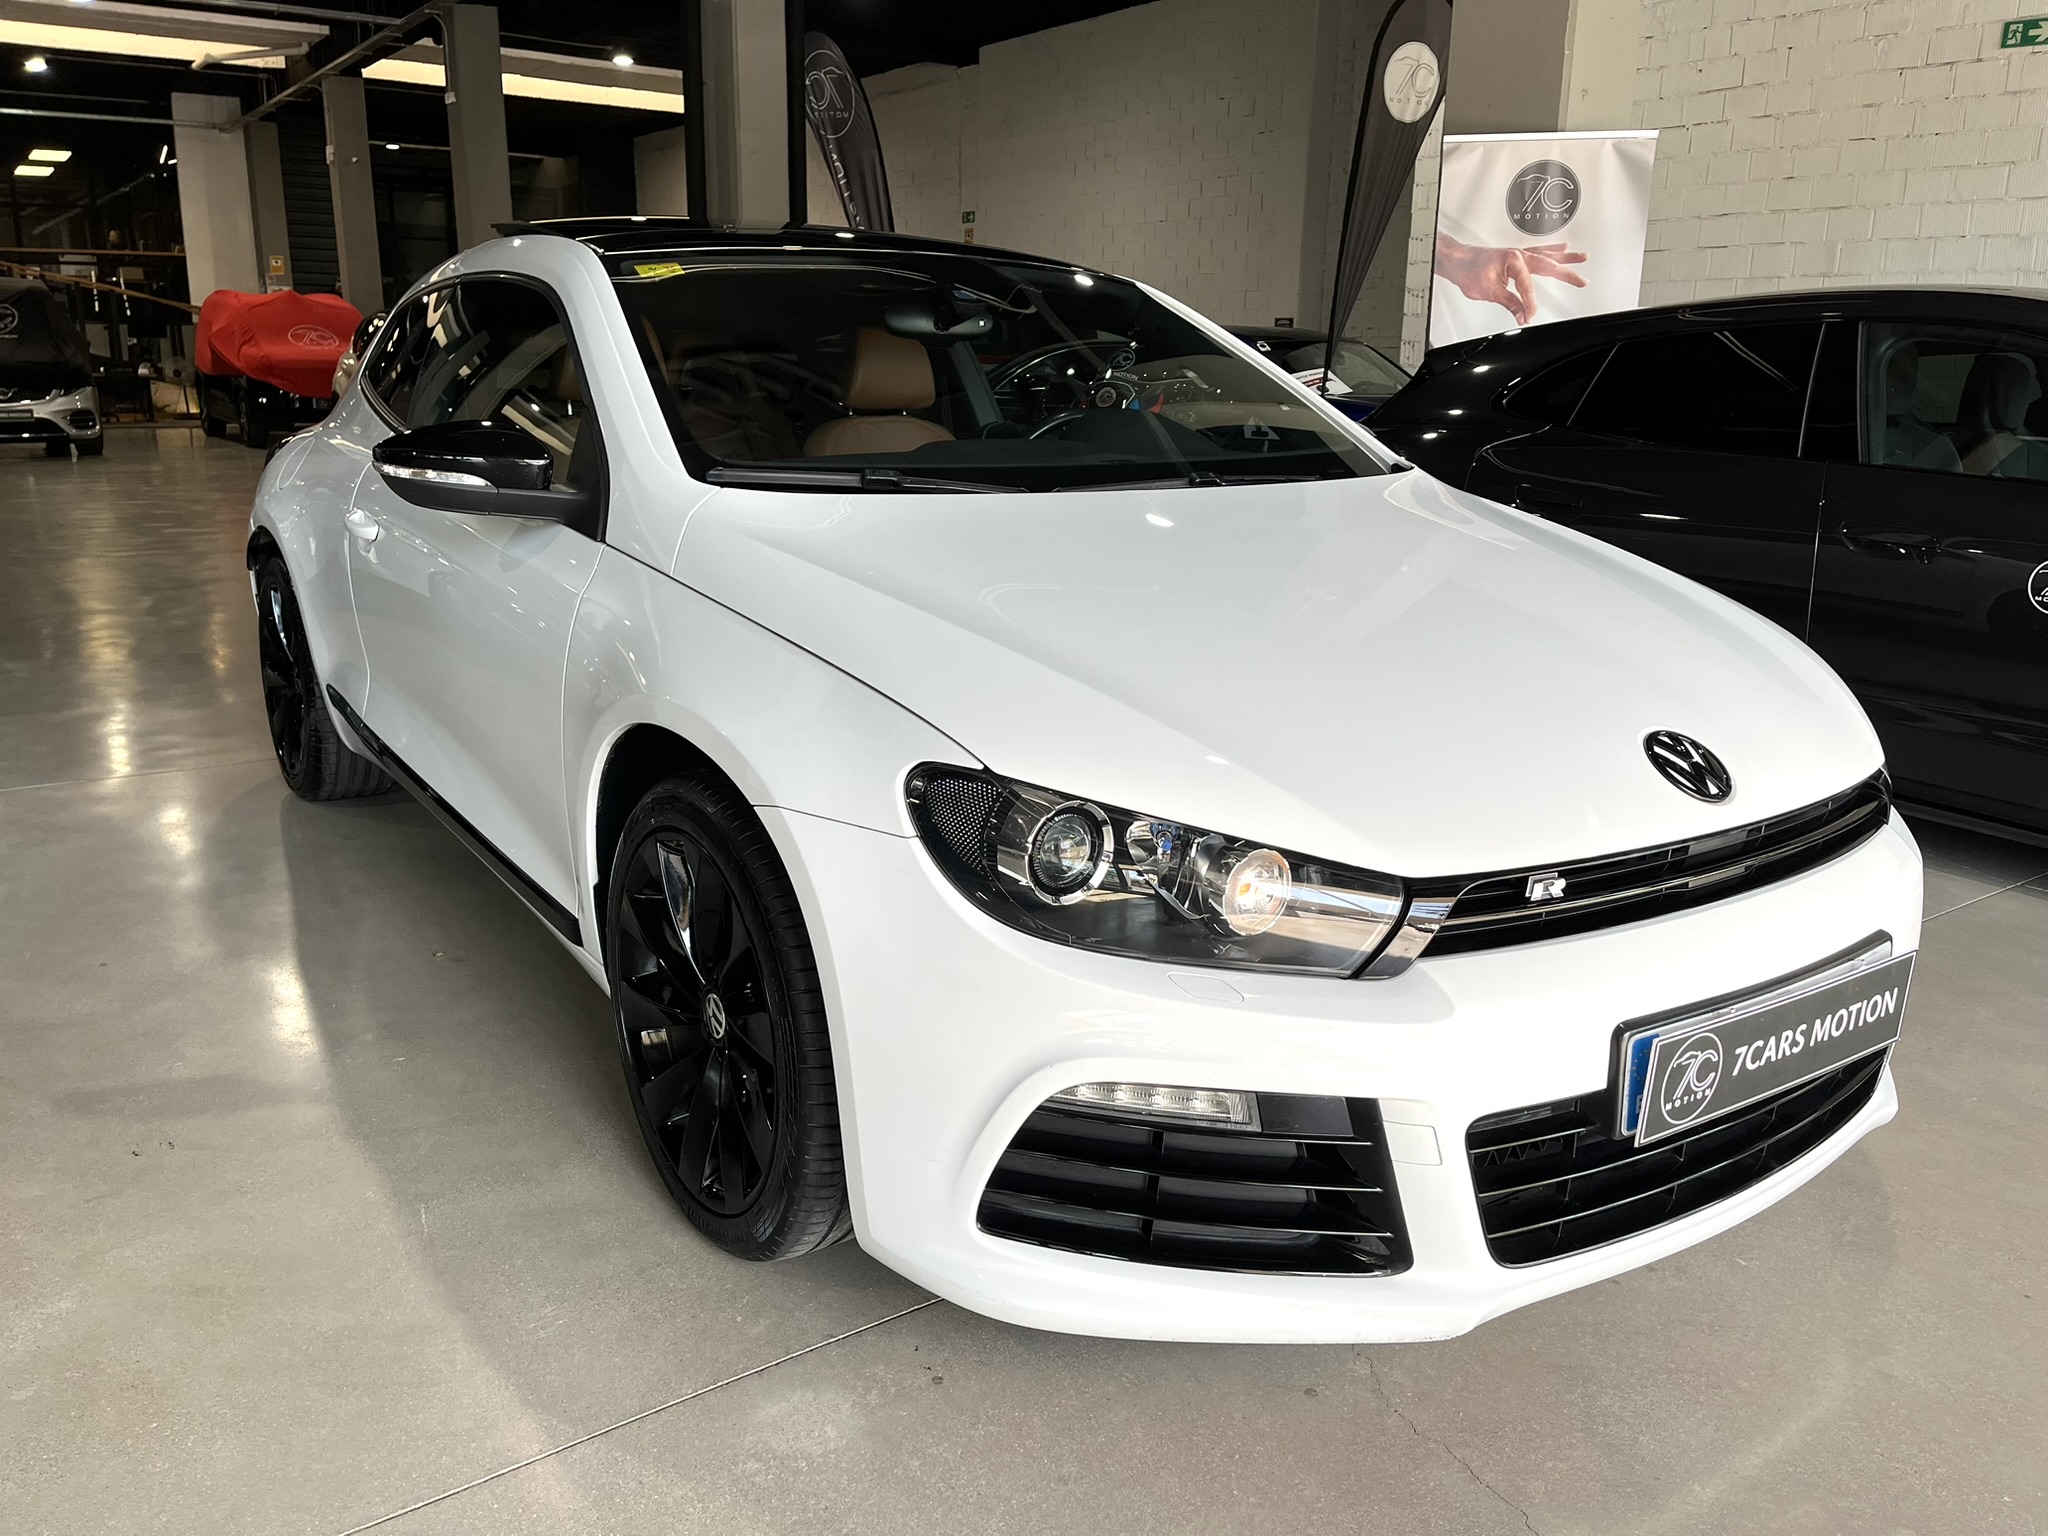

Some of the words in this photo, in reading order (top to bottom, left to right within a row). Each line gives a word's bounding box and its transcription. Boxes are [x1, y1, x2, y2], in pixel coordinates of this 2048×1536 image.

[1513, 212, 1570, 220] MOTION
[1525, 872, 1567, 901] R
[1732, 1023, 1808, 1077] 7CARS
[1809, 987, 1899, 1047] MOTION
[1665, 1087, 1712, 1111] MOTION
